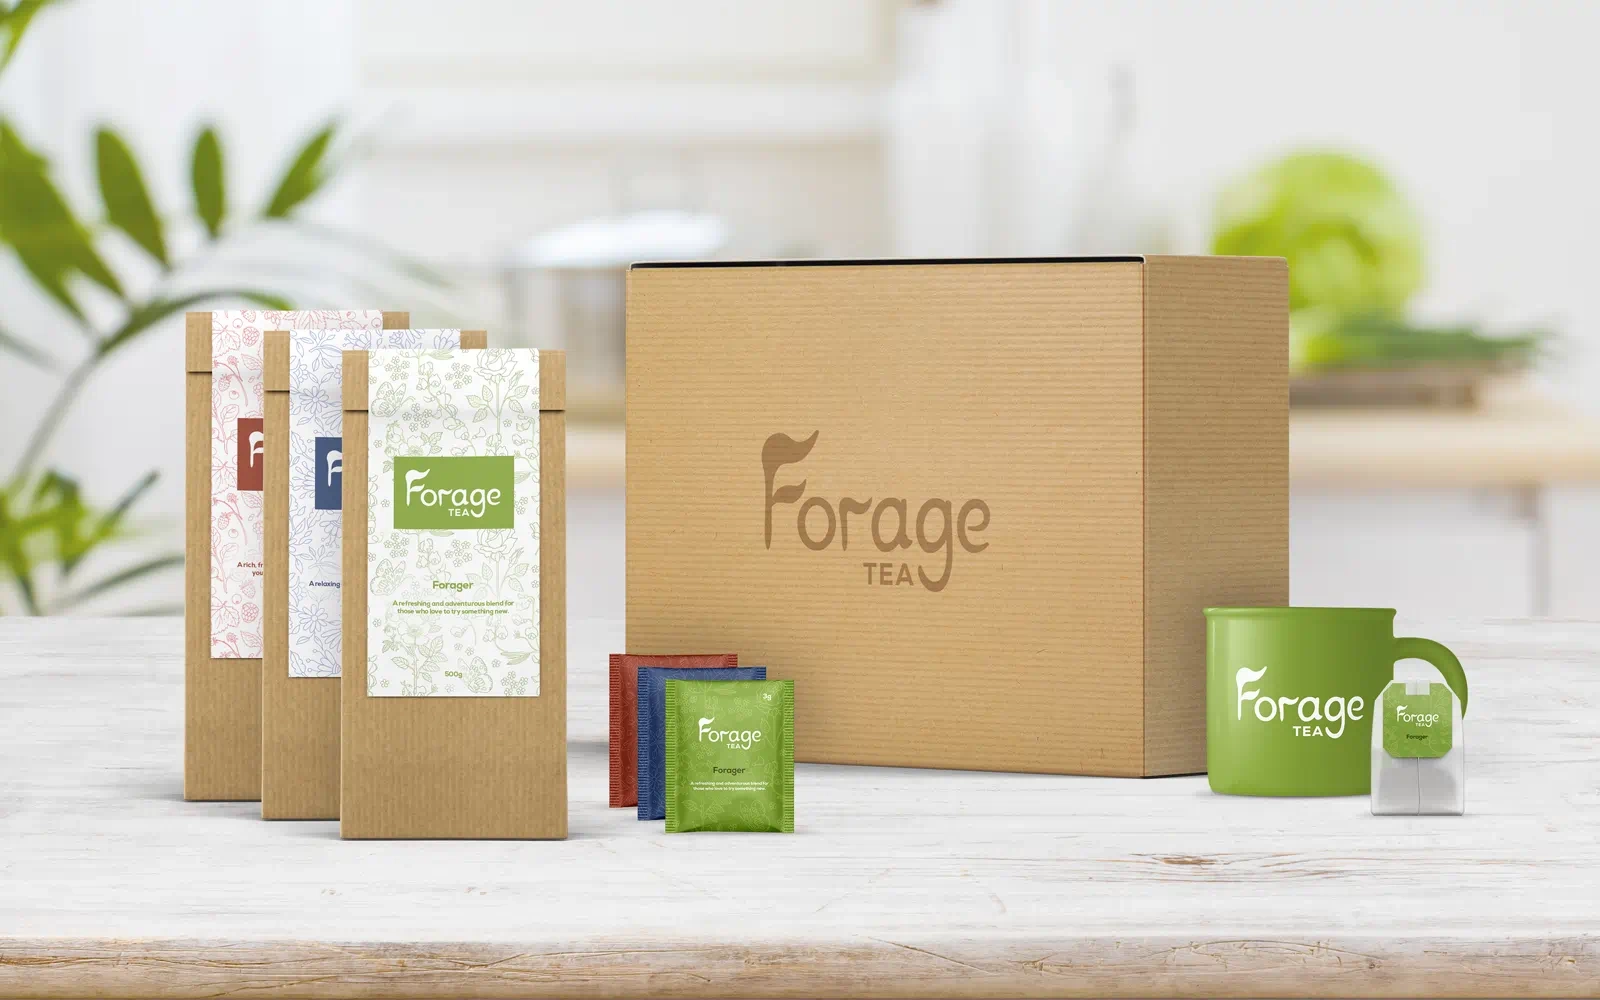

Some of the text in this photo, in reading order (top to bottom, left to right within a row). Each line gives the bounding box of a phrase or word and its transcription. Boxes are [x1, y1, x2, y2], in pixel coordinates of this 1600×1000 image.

[405, 468, 501, 518] Forage
[448, 508, 470, 517] TEA
[761, 429, 991, 593] Forage
[863, 562, 914, 586] TEA
[314, 580, 341, 589] relaxing
[432, 580, 474, 593] Forager
[398, 600, 431, 608] refreshing
[451, 608, 461, 616] try
[461, 608, 494, 616] something
[444, 670, 463, 679] 500g
[1235, 665, 1365, 739] Forage
[1396, 705, 1440, 728] Forage
[698, 717, 762, 750] Forage
[1292, 725, 1324, 737] TEA
[712, 766, 746, 776] Forager
